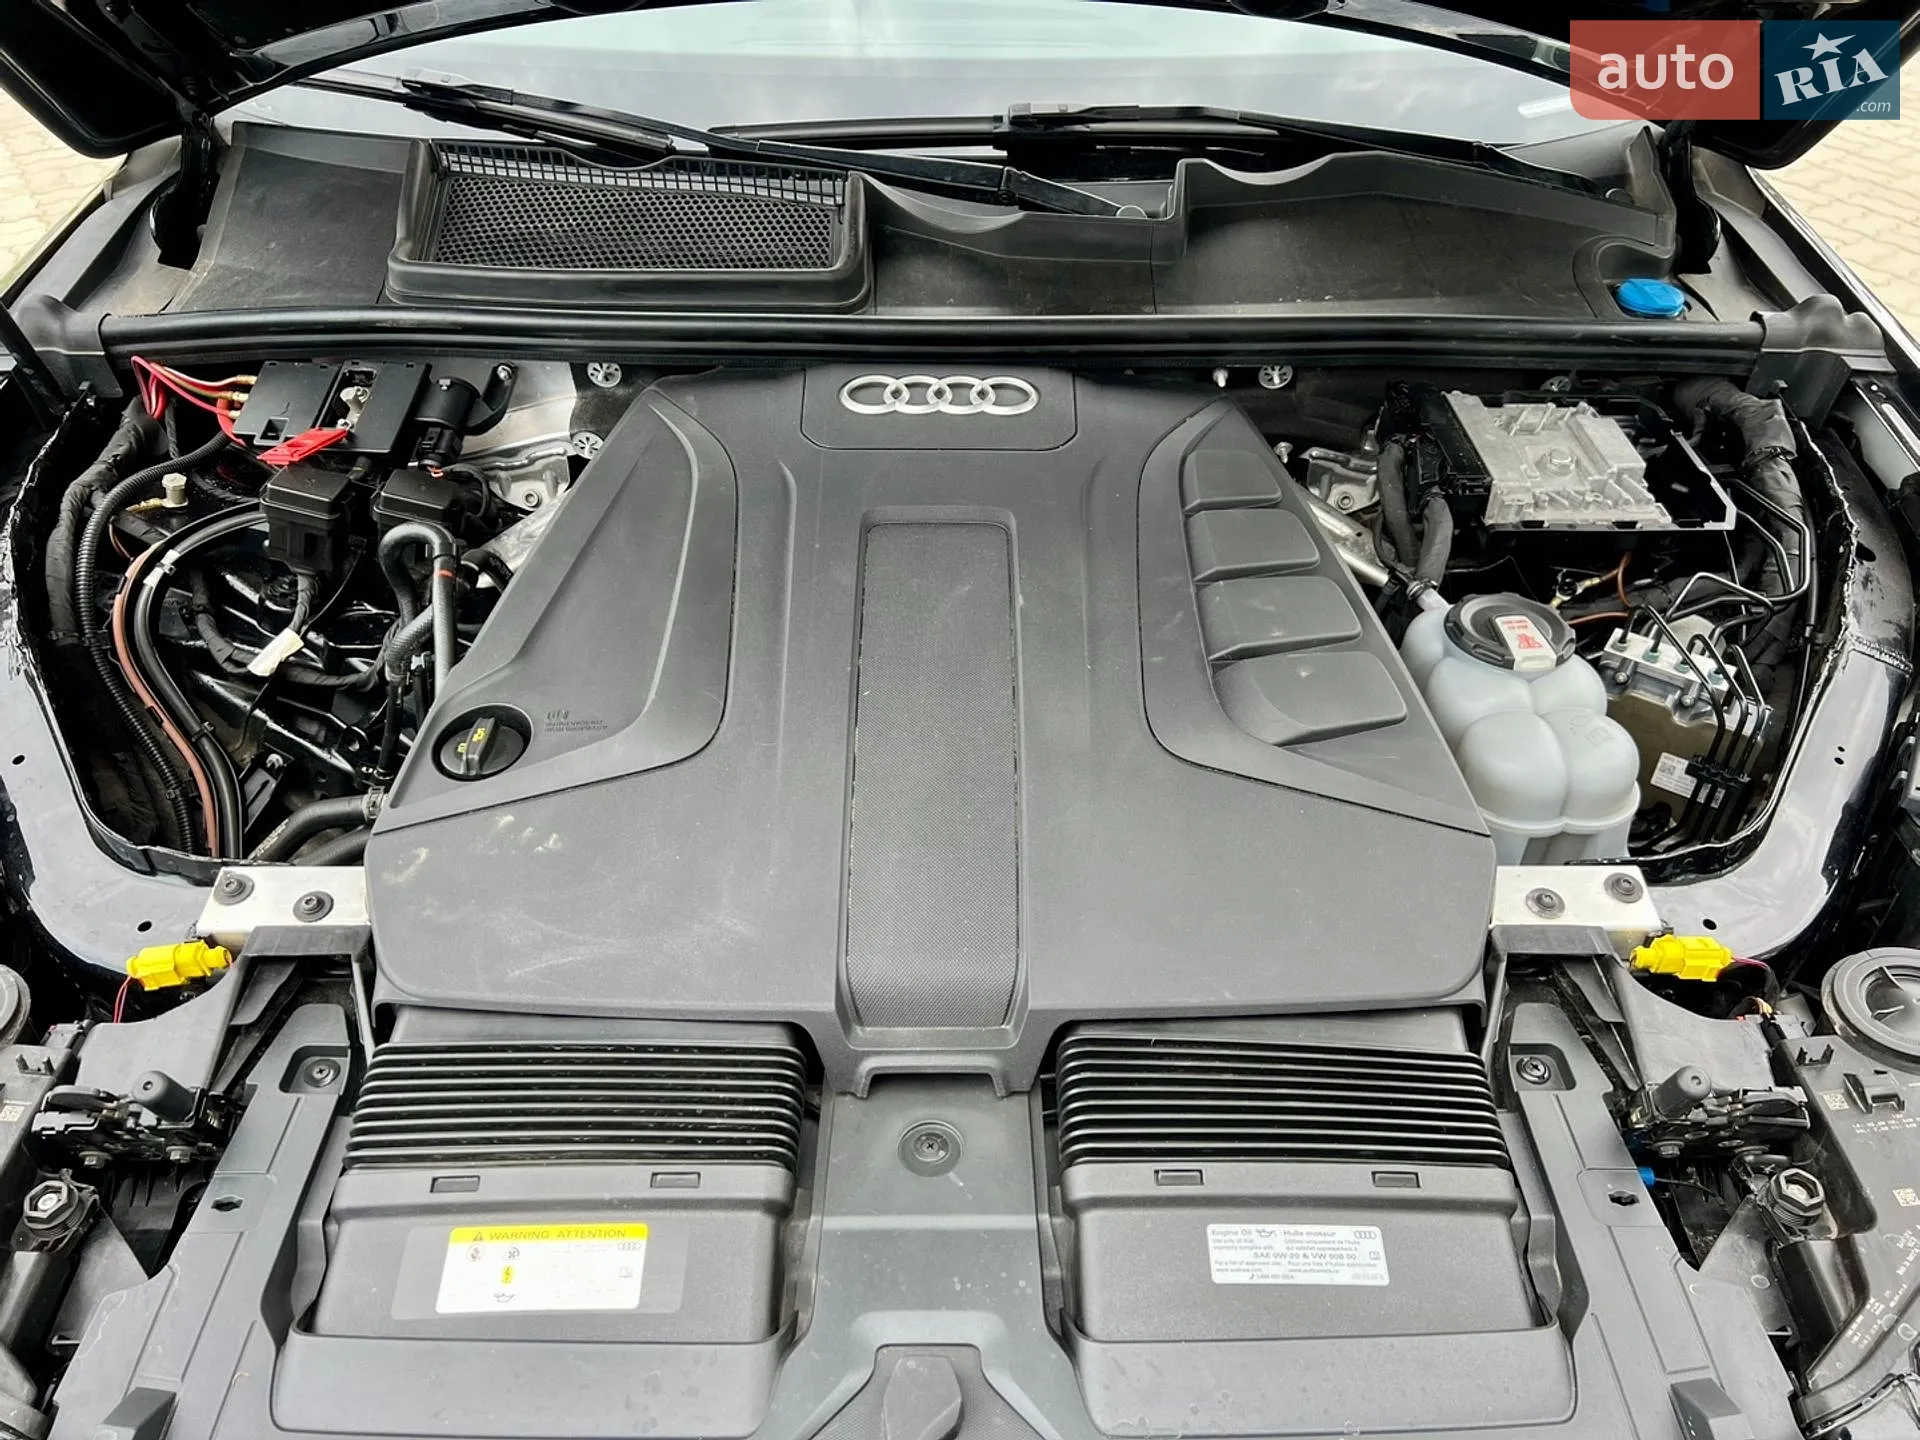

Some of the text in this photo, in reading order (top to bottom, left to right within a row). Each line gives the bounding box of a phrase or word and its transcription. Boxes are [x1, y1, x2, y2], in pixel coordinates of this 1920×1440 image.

[490, 1229, 626, 1240] WARNING ATTENTION
[1253, 1251, 1271, 1259] SAE
